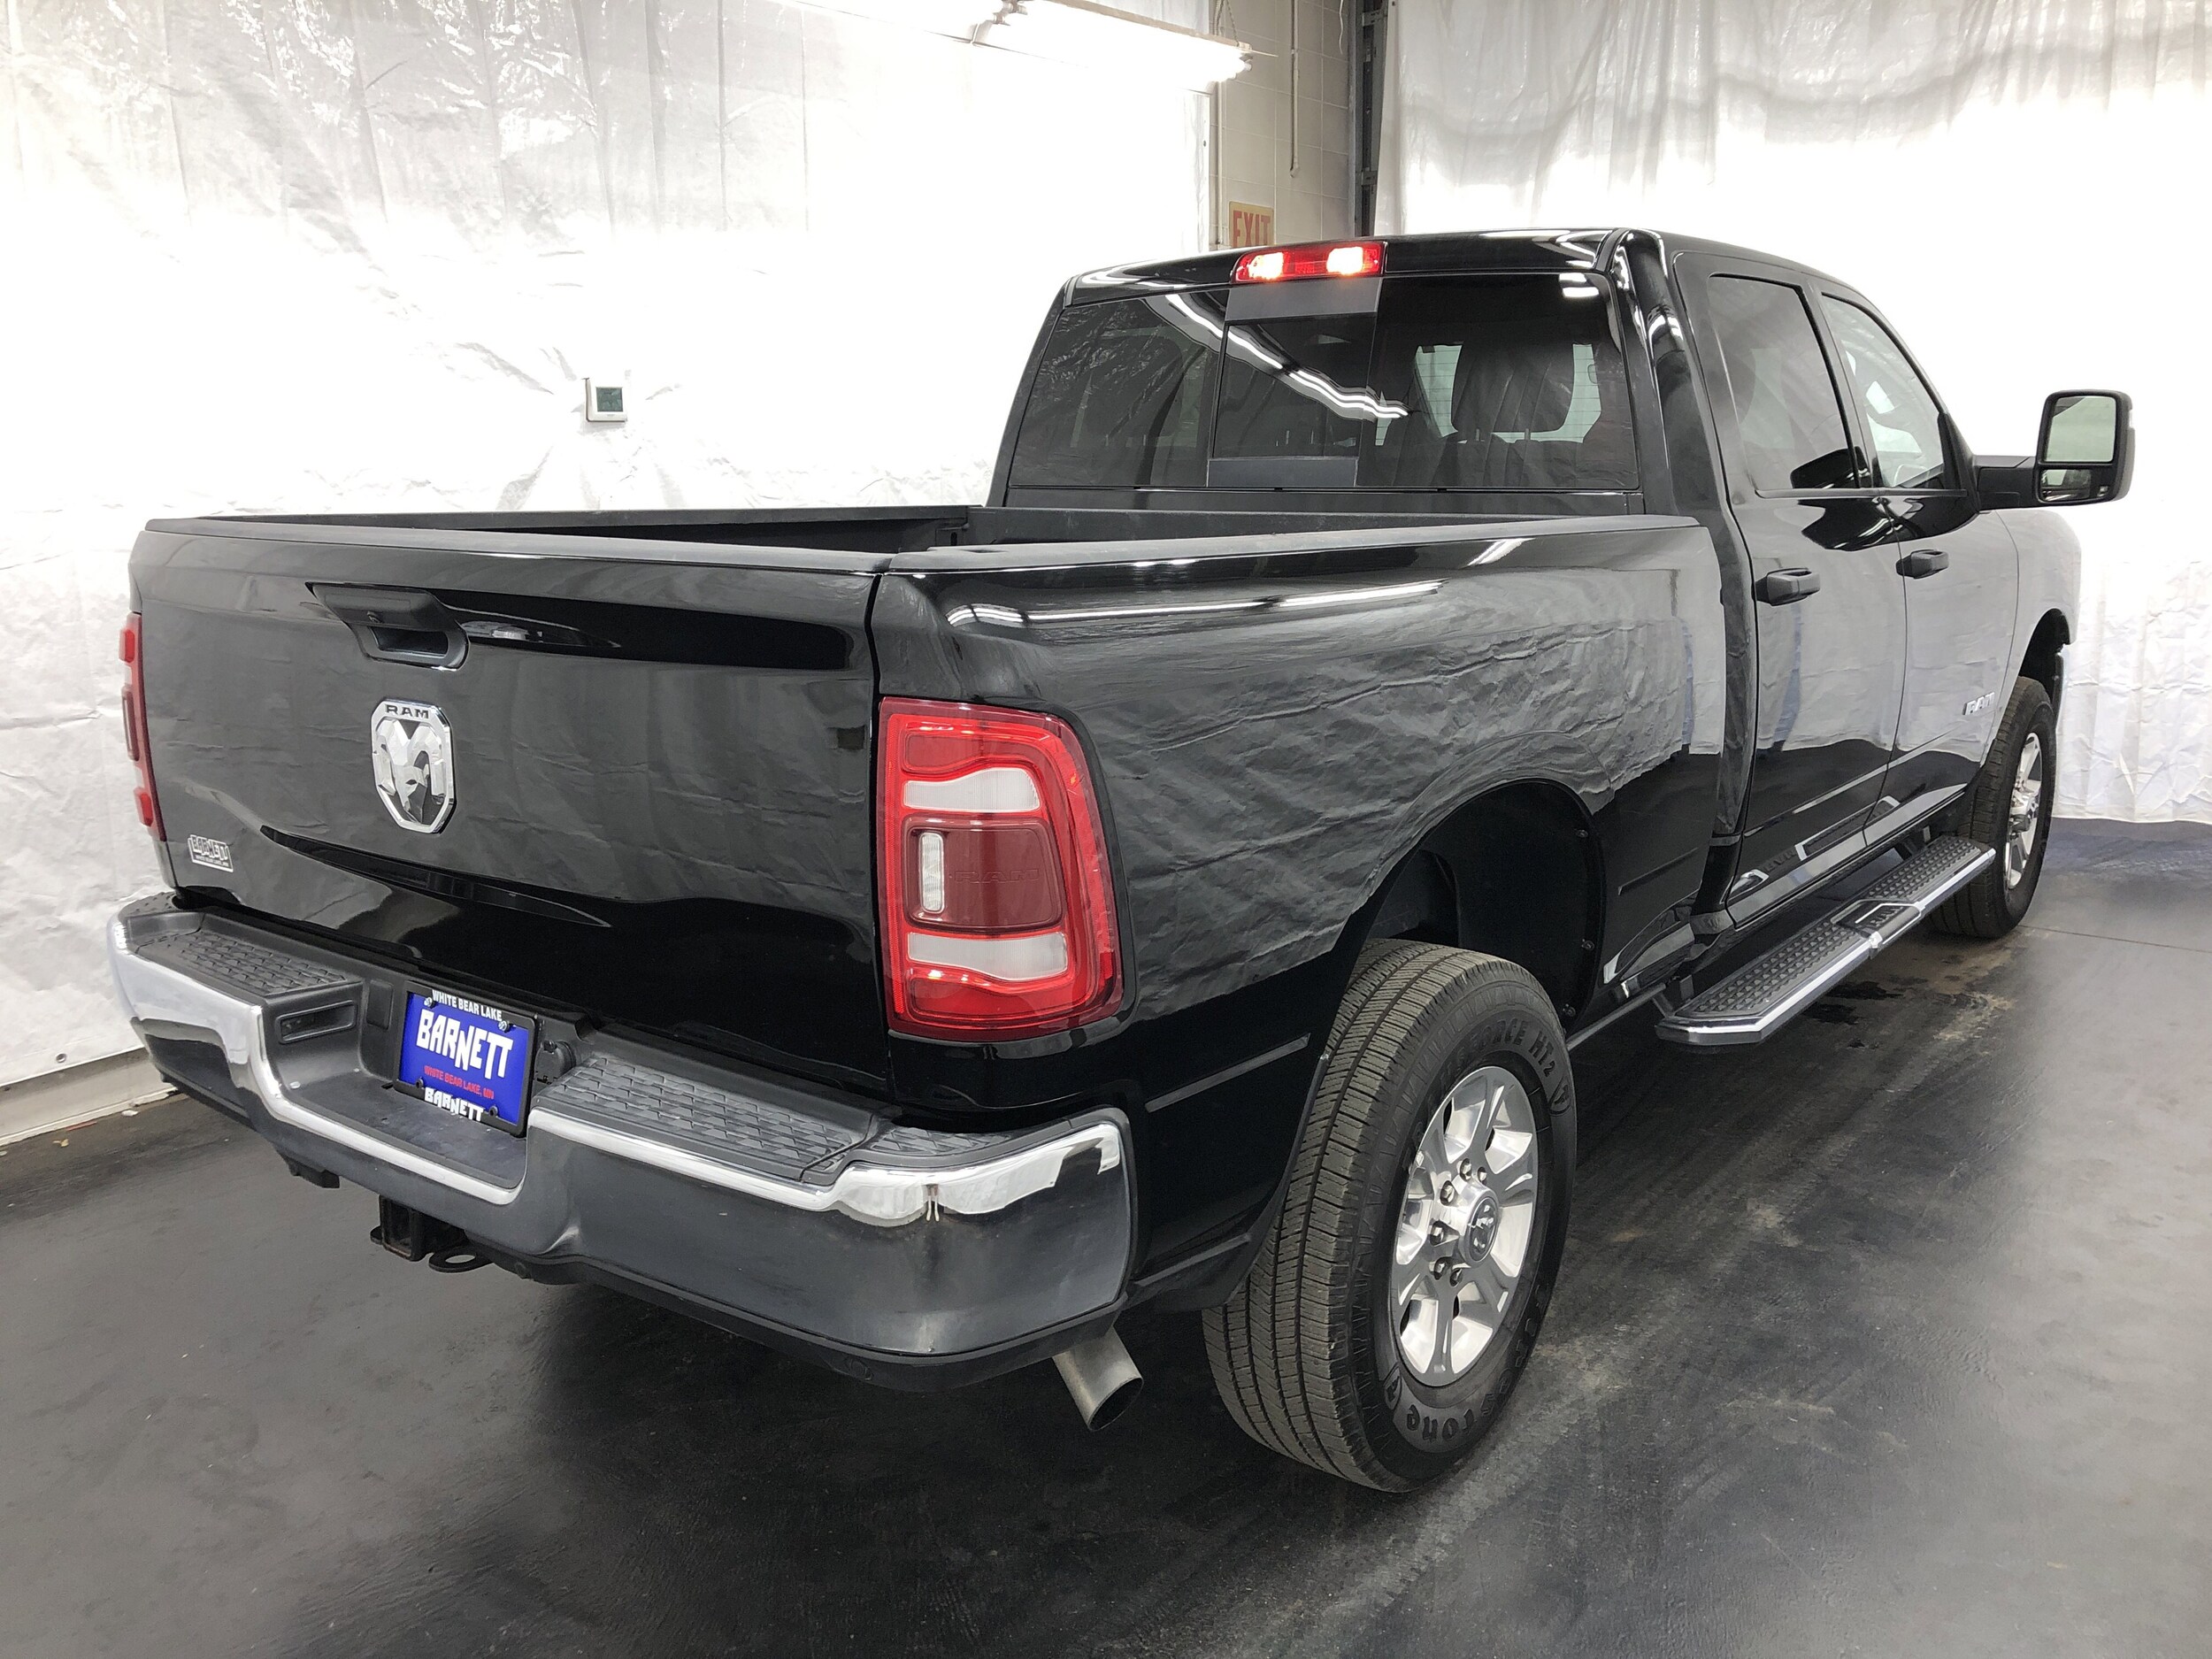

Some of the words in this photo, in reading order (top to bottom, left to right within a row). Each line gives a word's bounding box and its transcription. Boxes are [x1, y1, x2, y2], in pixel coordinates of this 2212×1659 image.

[1233, 211, 1271, 248] EXIT
[386, 704, 429, 719] RAM
[955, 869, 1040, 884] RAM
[432, 989, 457, 1009] WHITE
[458, 997, 480, 1017] BEAR
[480, 1005, 503, 1022] LAKE
[417, 1009, 514, 1079] BARNETT
[425, 1065, 443, 1080] WHITE
[444, 1072, 463, 1088] BEAR
[425, 1087, 485, 1122] BARNETT
